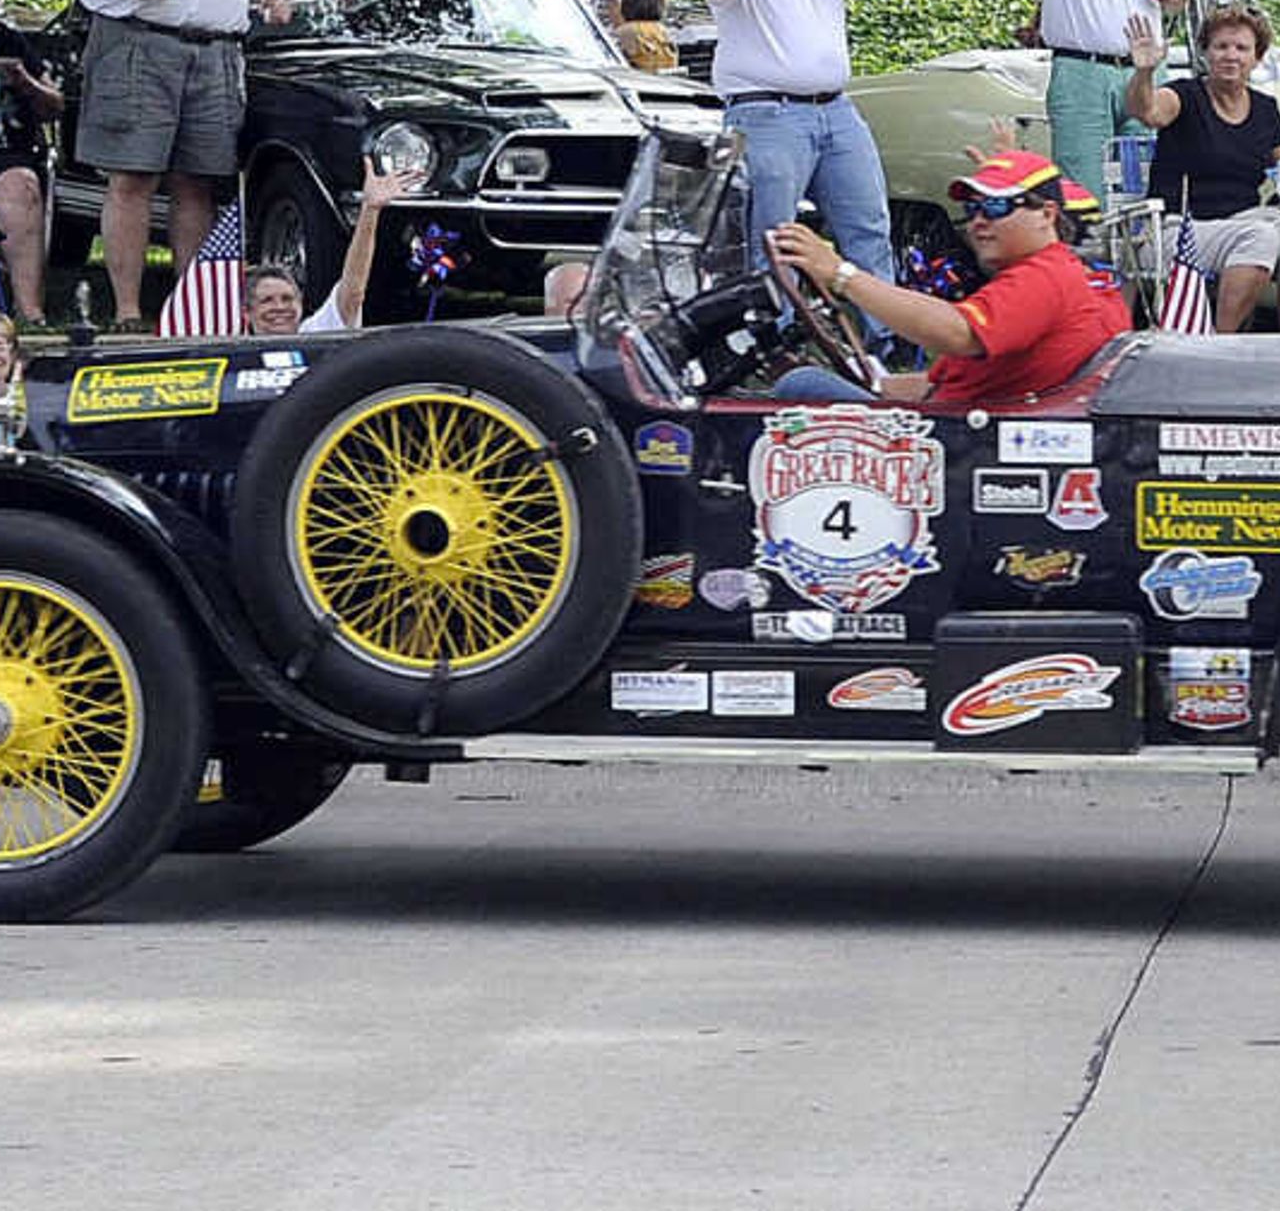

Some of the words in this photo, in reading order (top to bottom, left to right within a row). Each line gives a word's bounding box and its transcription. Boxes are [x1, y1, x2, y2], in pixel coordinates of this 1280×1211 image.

[87, 367, 208, 390] Hemmings
[76, 390, 142, 410] Motor
[152, 386, 212, 406] News
[767, 447, 847, 501] GREAT
[850, 449, 915, 506] RACE
[821, 499, 858, 541] 4
[1144, 516, 1222, 540] Motor
